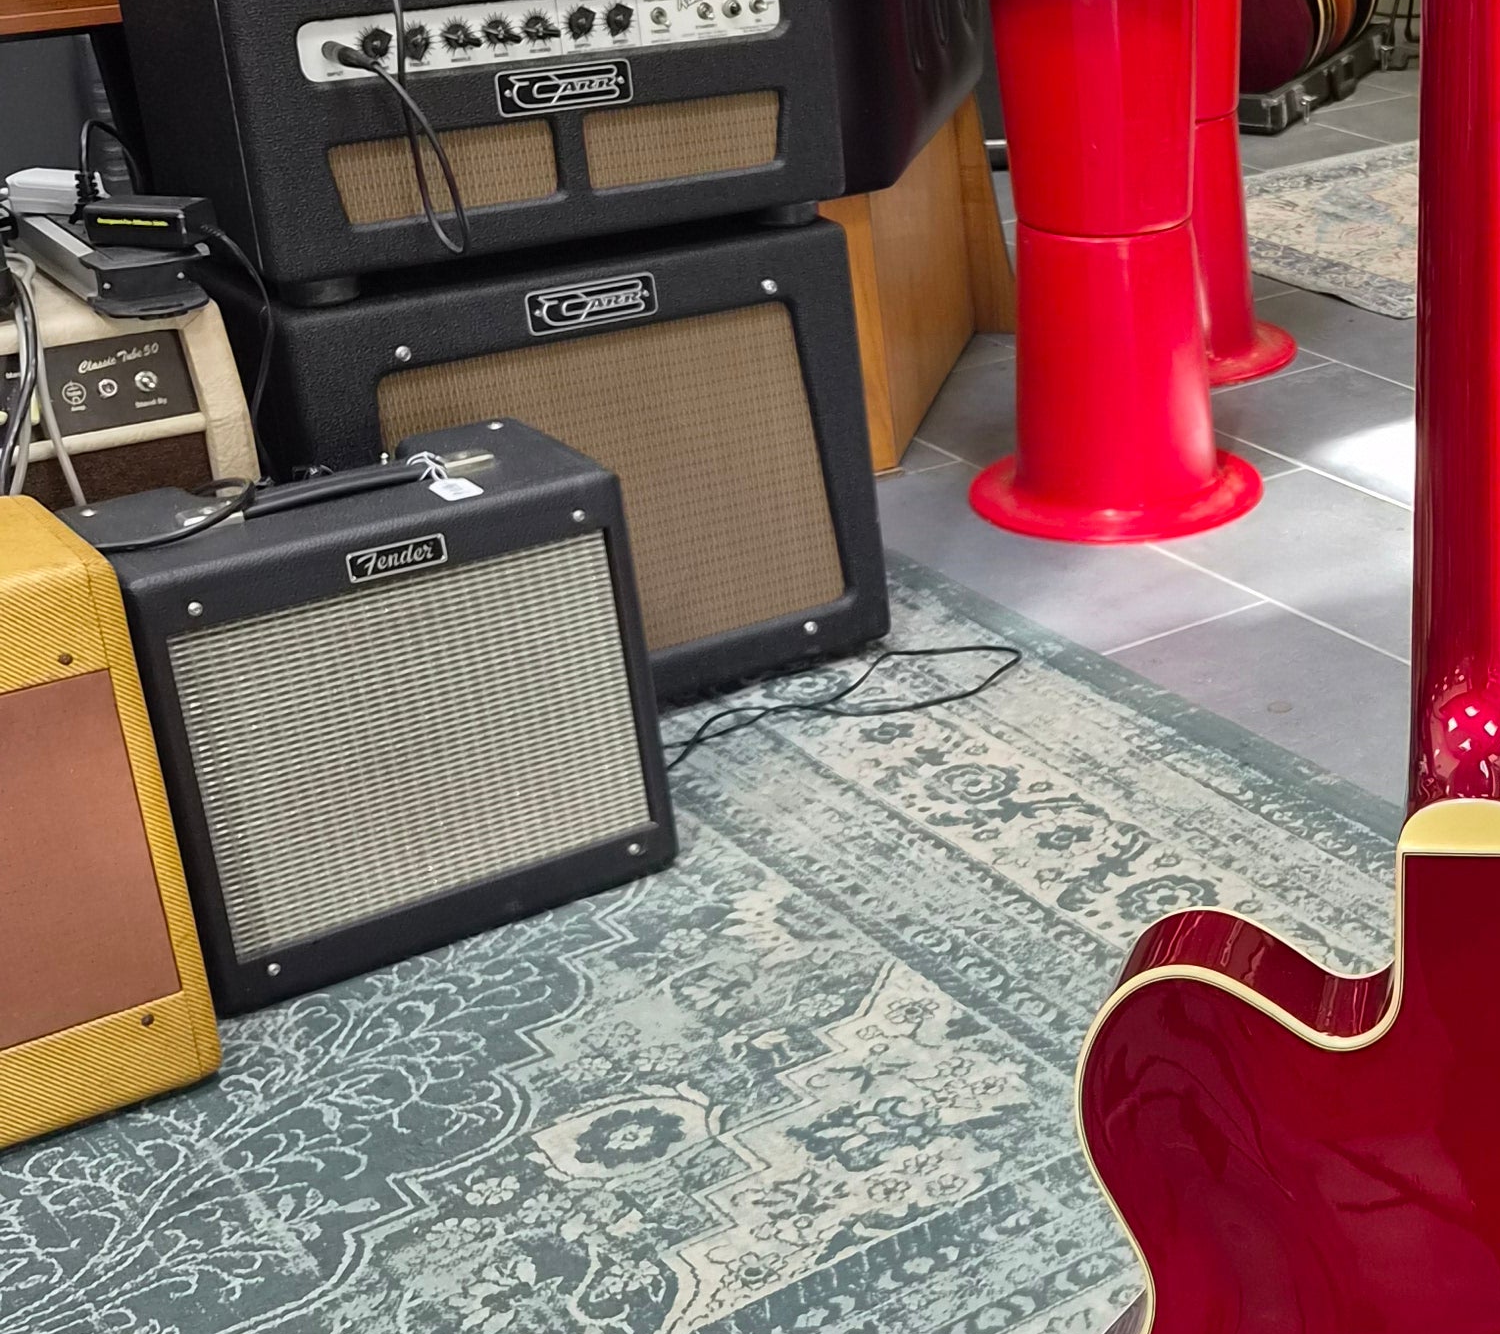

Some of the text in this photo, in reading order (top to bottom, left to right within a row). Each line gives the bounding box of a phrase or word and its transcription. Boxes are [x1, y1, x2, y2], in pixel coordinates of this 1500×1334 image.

[77, 342, 161, 375] Classic Tube 50
[356, 543, 434, 576] Fender
